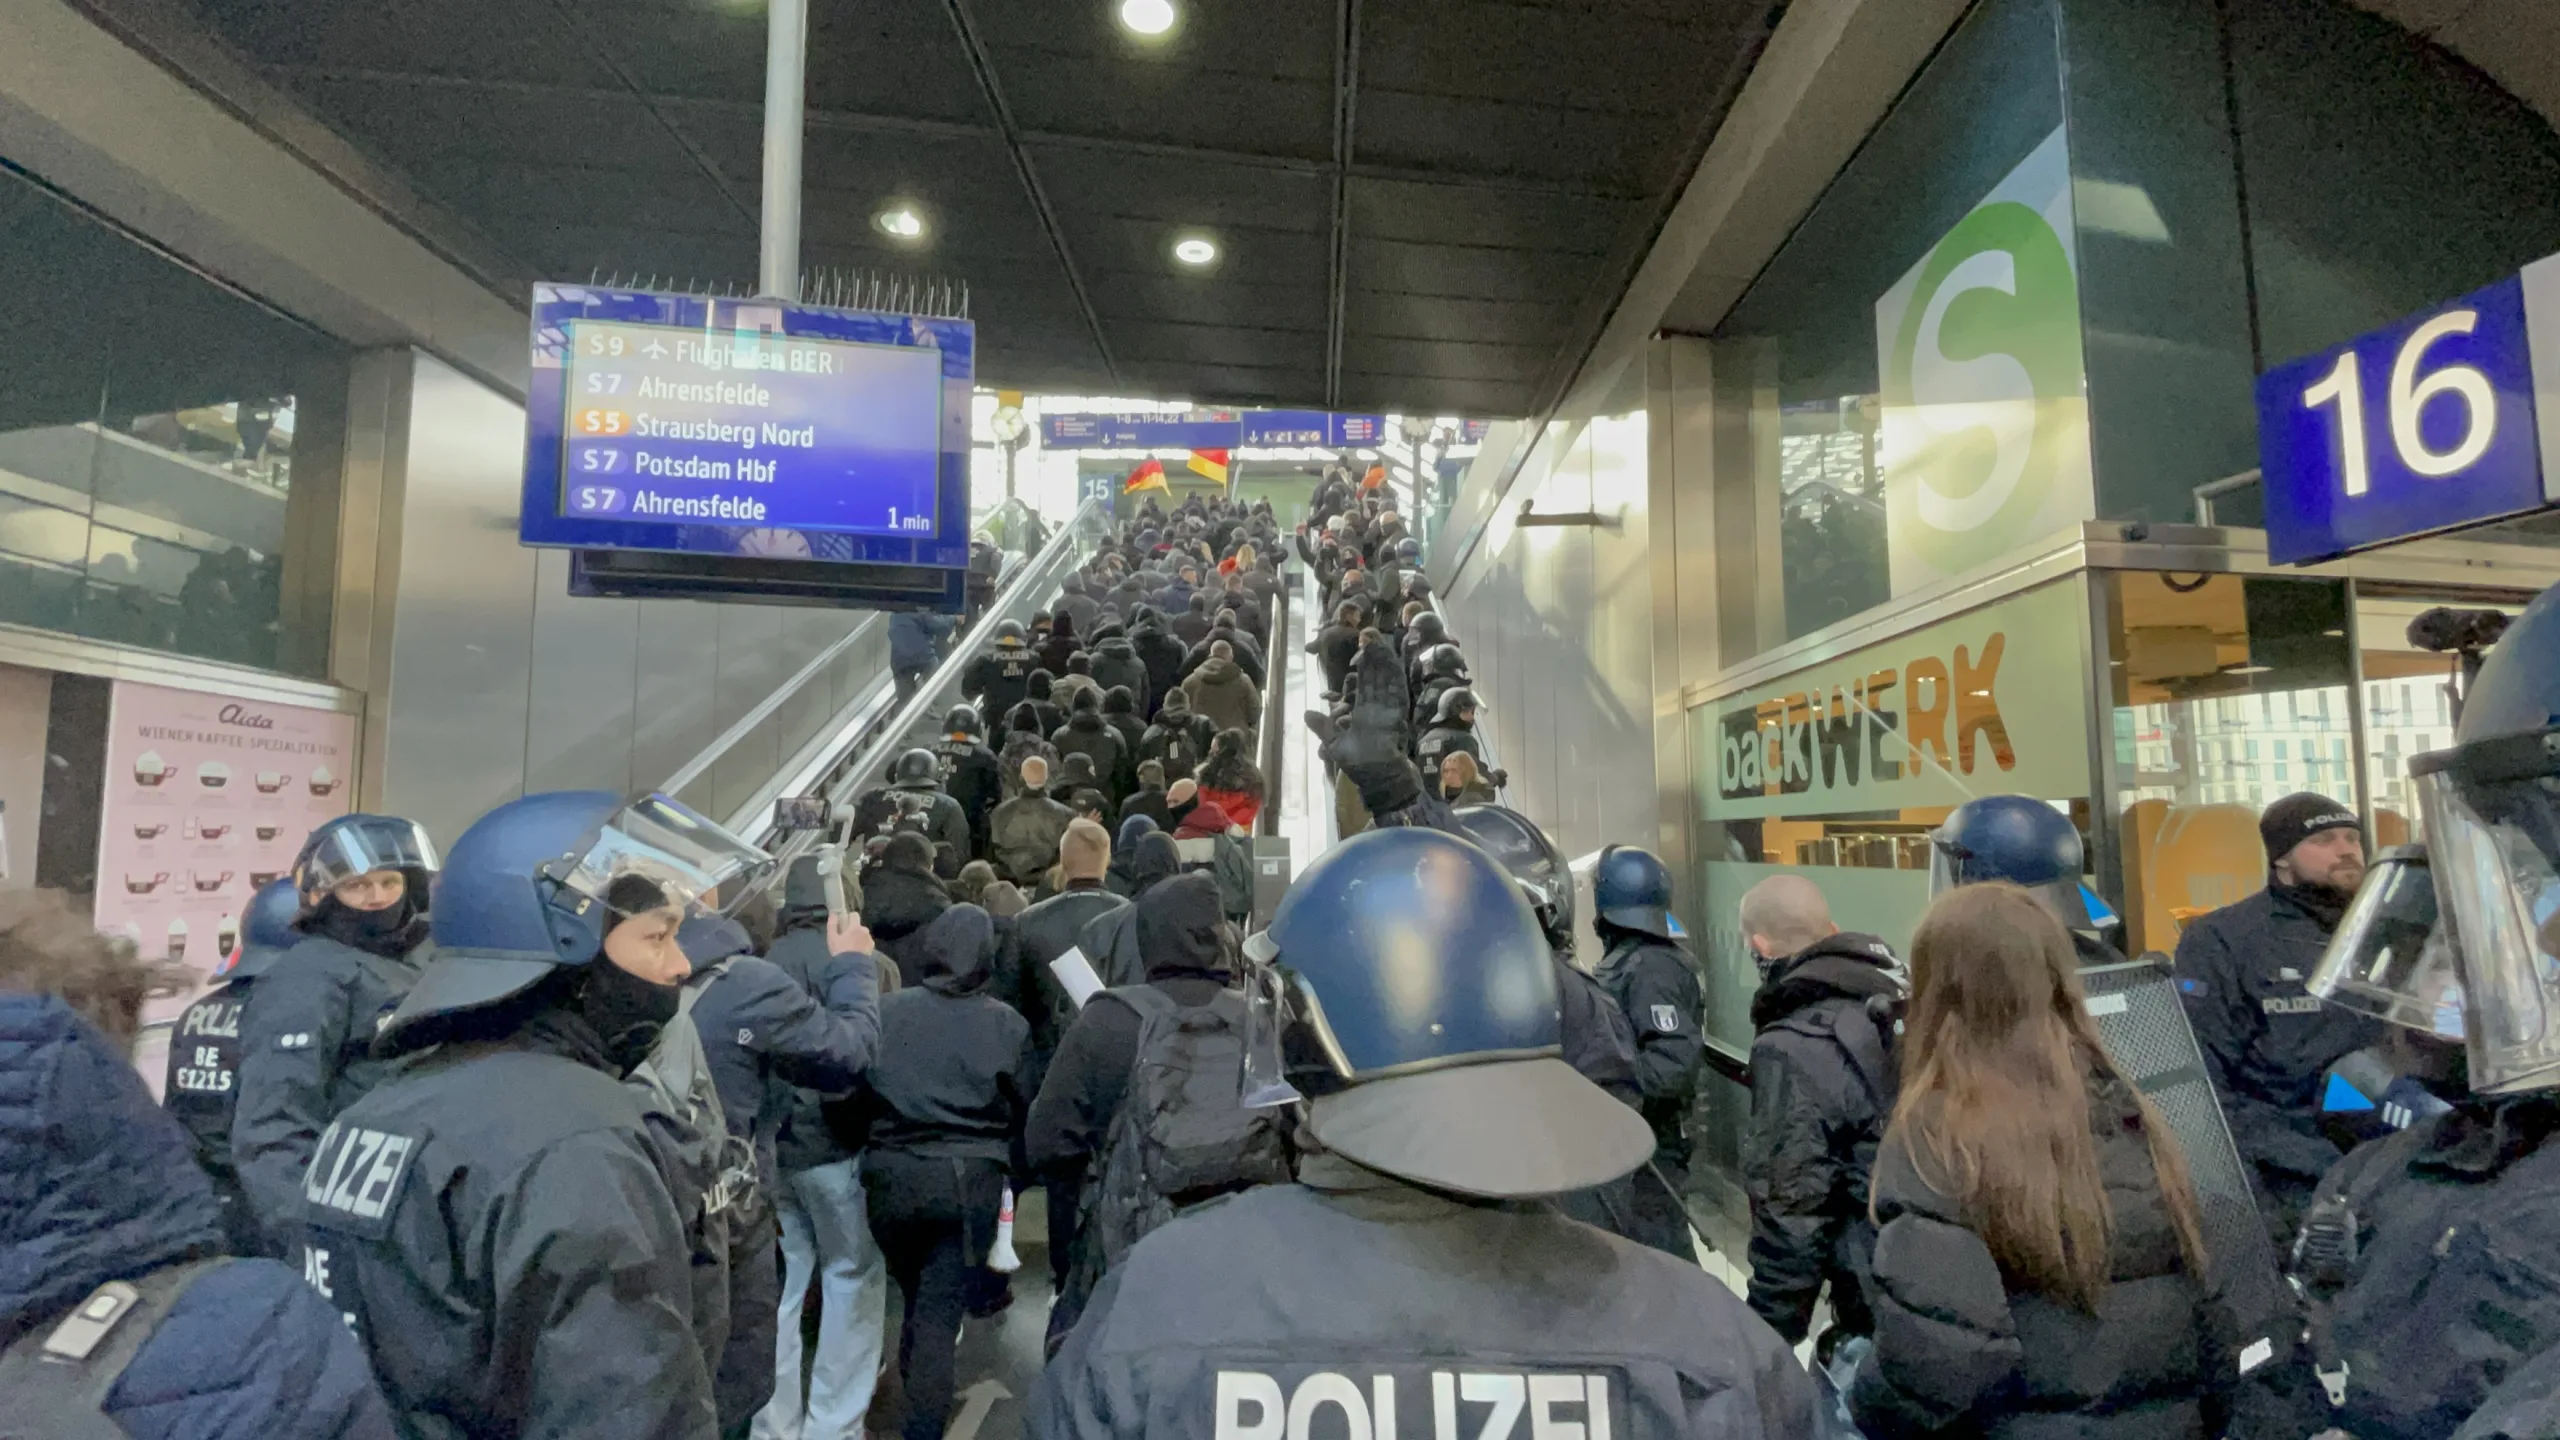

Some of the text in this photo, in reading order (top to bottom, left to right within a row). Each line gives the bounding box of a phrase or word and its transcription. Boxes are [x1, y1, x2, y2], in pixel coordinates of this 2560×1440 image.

[589, 334, 625, 356] S9
[790, 350, 833, 374] BER
[587, 373, 770, 407] S7 Ahrensfelde
[1911, 249, 2037, 532] S
[2303, 310, 2497, 497] 16
[585, 411, 814, 449] S5 Strausberg Nord
[583, 449, 777, 483] S7 Potsdam Hbf
[1085, 479, 1109, 500] 15
[581, 488, 930, 531] S7 Ahrensfelde 1 min
[138, 724, 193, 743] WIENER
[197, 732, 244, 749] KAFFEE
[195, 1046, 219, 1068] BE
